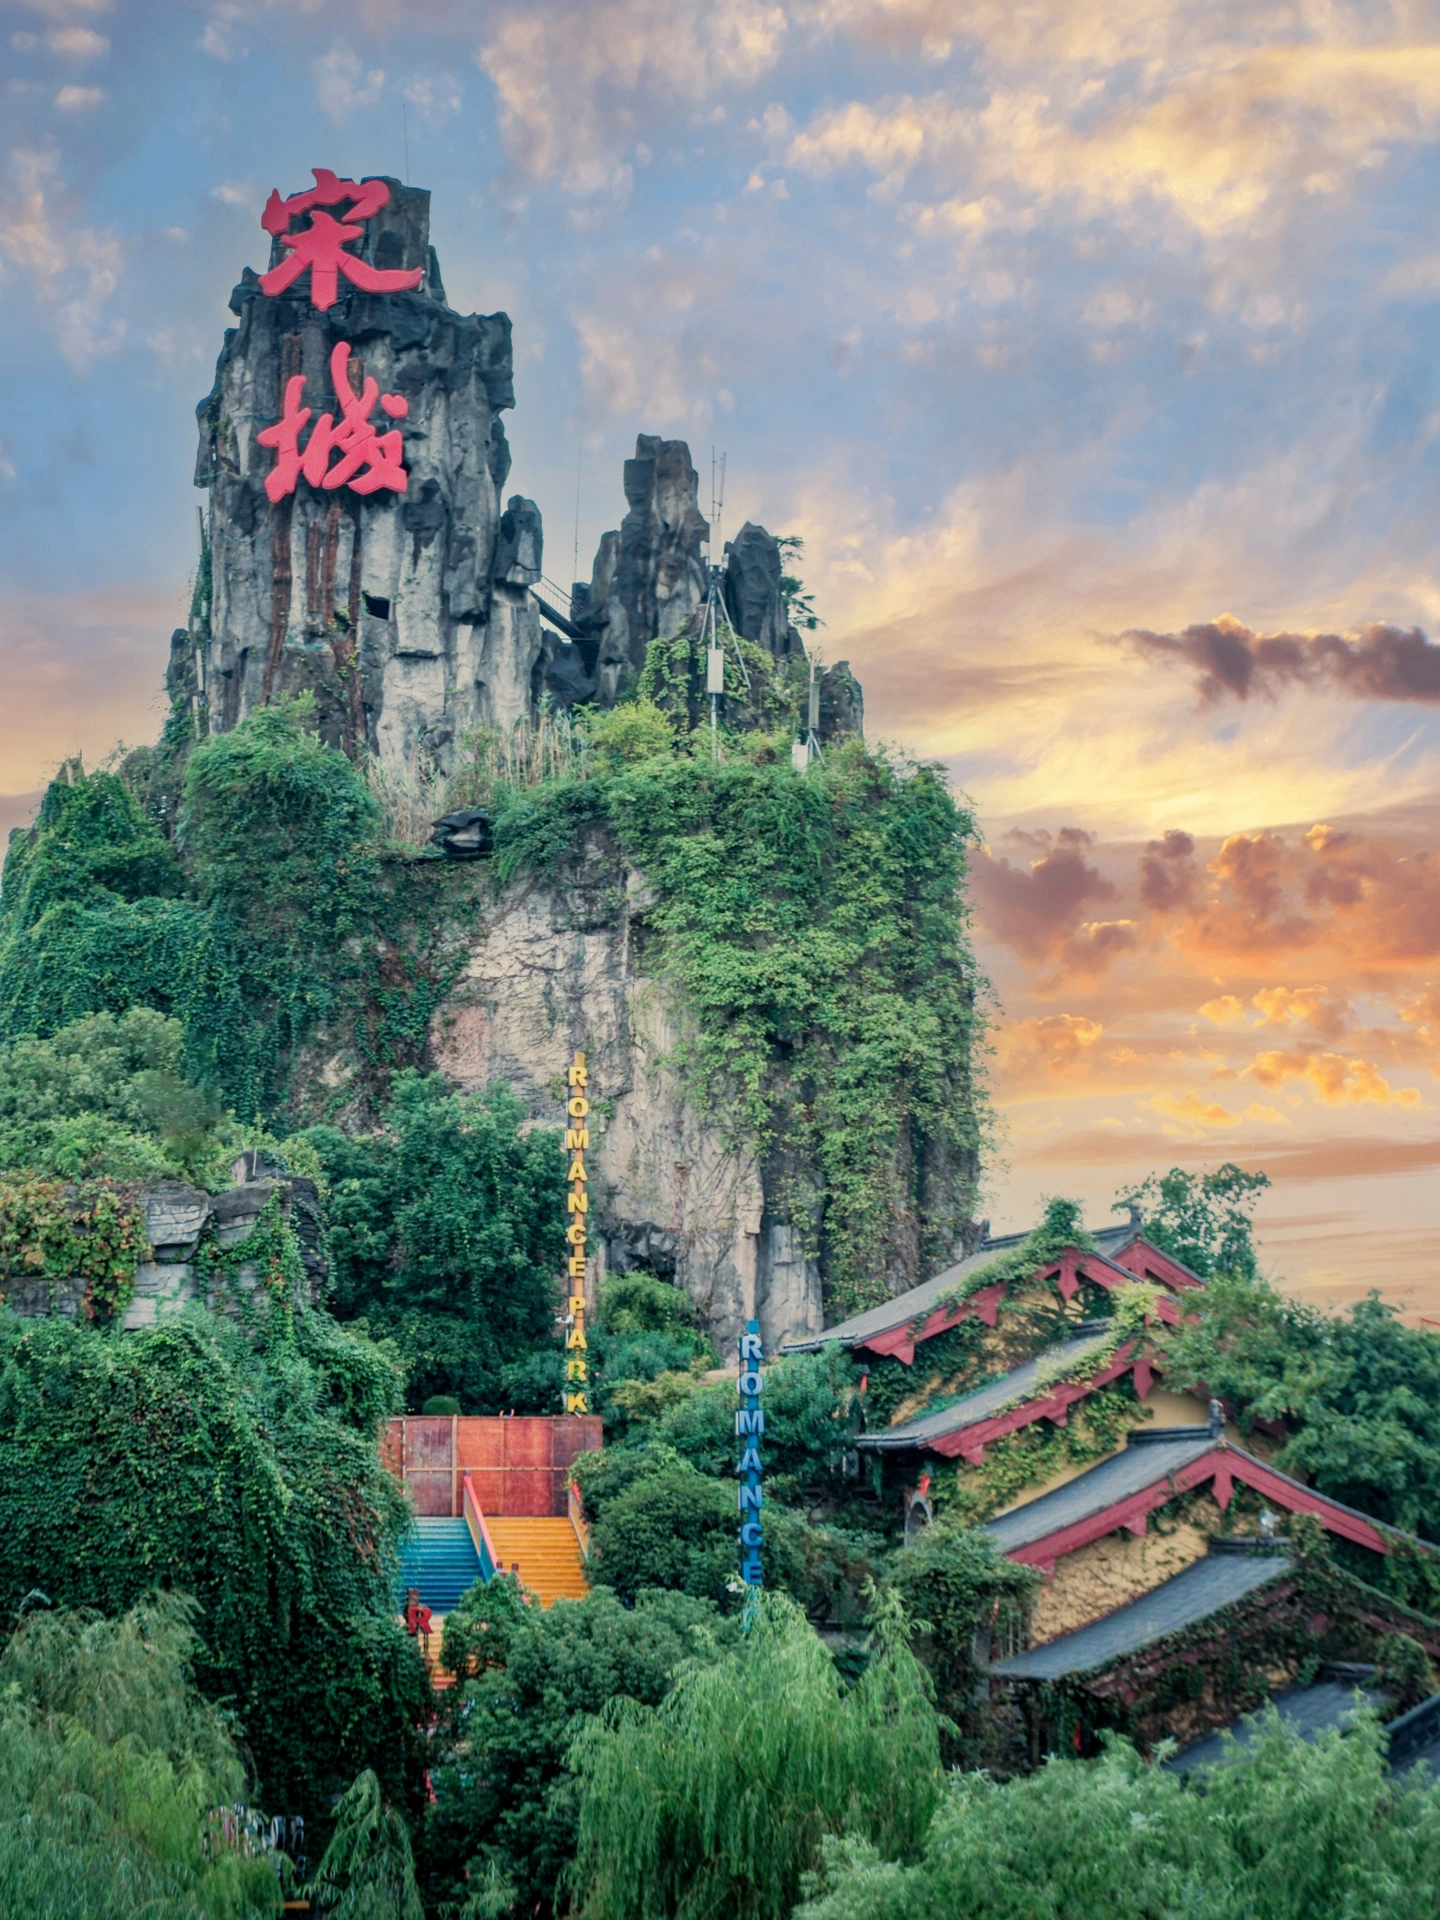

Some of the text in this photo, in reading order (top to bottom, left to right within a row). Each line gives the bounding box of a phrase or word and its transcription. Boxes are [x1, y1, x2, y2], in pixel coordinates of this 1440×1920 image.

[258, 168, 423, 503] 宋城
[566, 1066, 590, 1413] ROMANCE PARK
[738, 1334, 765, 1585] ROMANCE
